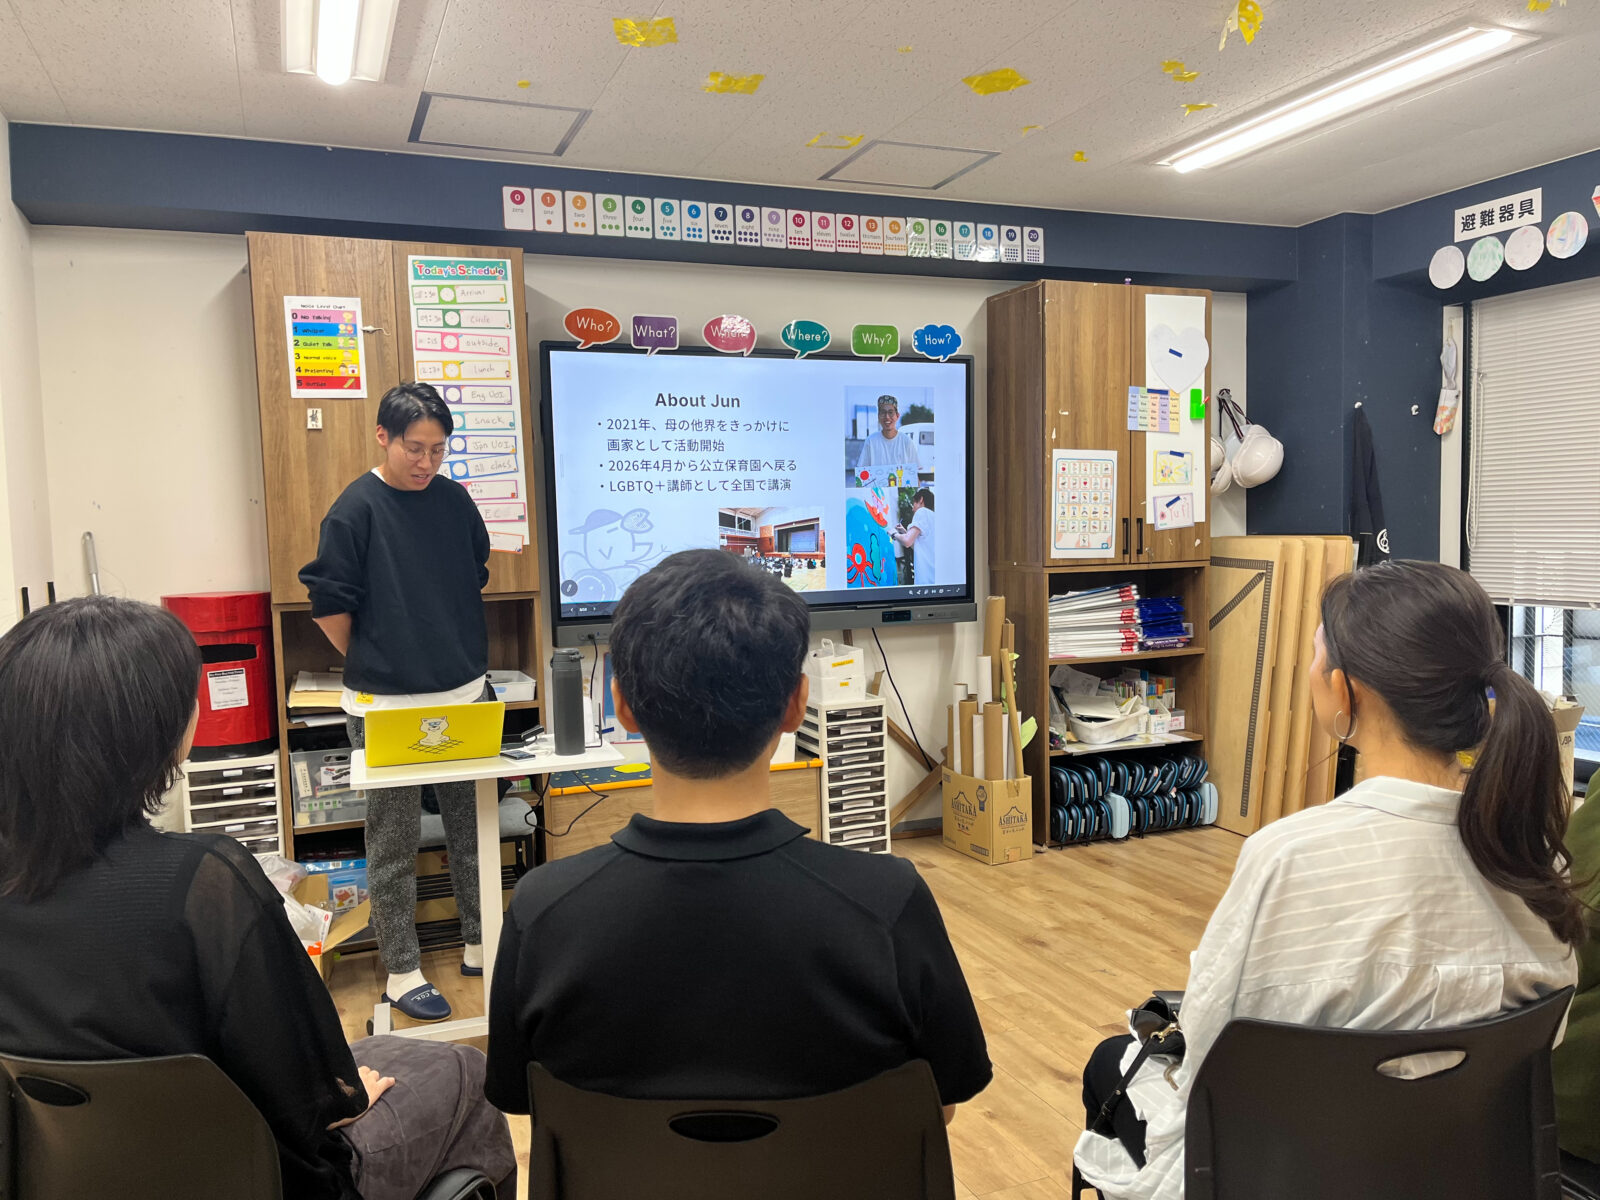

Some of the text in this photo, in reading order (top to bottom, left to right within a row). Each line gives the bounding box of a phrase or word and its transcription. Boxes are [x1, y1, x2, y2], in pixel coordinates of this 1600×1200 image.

[1461, 198, 1535, 233] 避難器具
[961, 227, 968, 235] 17
[1008, 231, 1015, 239] 19
[416, 264, 504, 277] Today's Schedule
[291, 312, 298, 320] 0
[293, 325, 298, 333] 1
[576, 315, 613, 332] Who?
[634, 324, 676, 338] What?
[785, 328, 828, 342] Where?
[294, 339, 300, 347] 2
[862, 333, 892, 347] Why?
[924, 333, 952, 345] How?
[295, 352, 301, 360] 3
[296, 379, 303, 387] 5
[655, 392, 741, 408] About Jun
[606, 417, 790, 432] 2021年、母の他界をきっかけに
[607, 438, 725, 452] 画家として活動開始
[608, 458, 797, 472] 2026年4月から公立保育園へ戻る
[951, 798, 977, 817] ASHITAKA
[999, 812, 1028, 826] ASHITAKA
